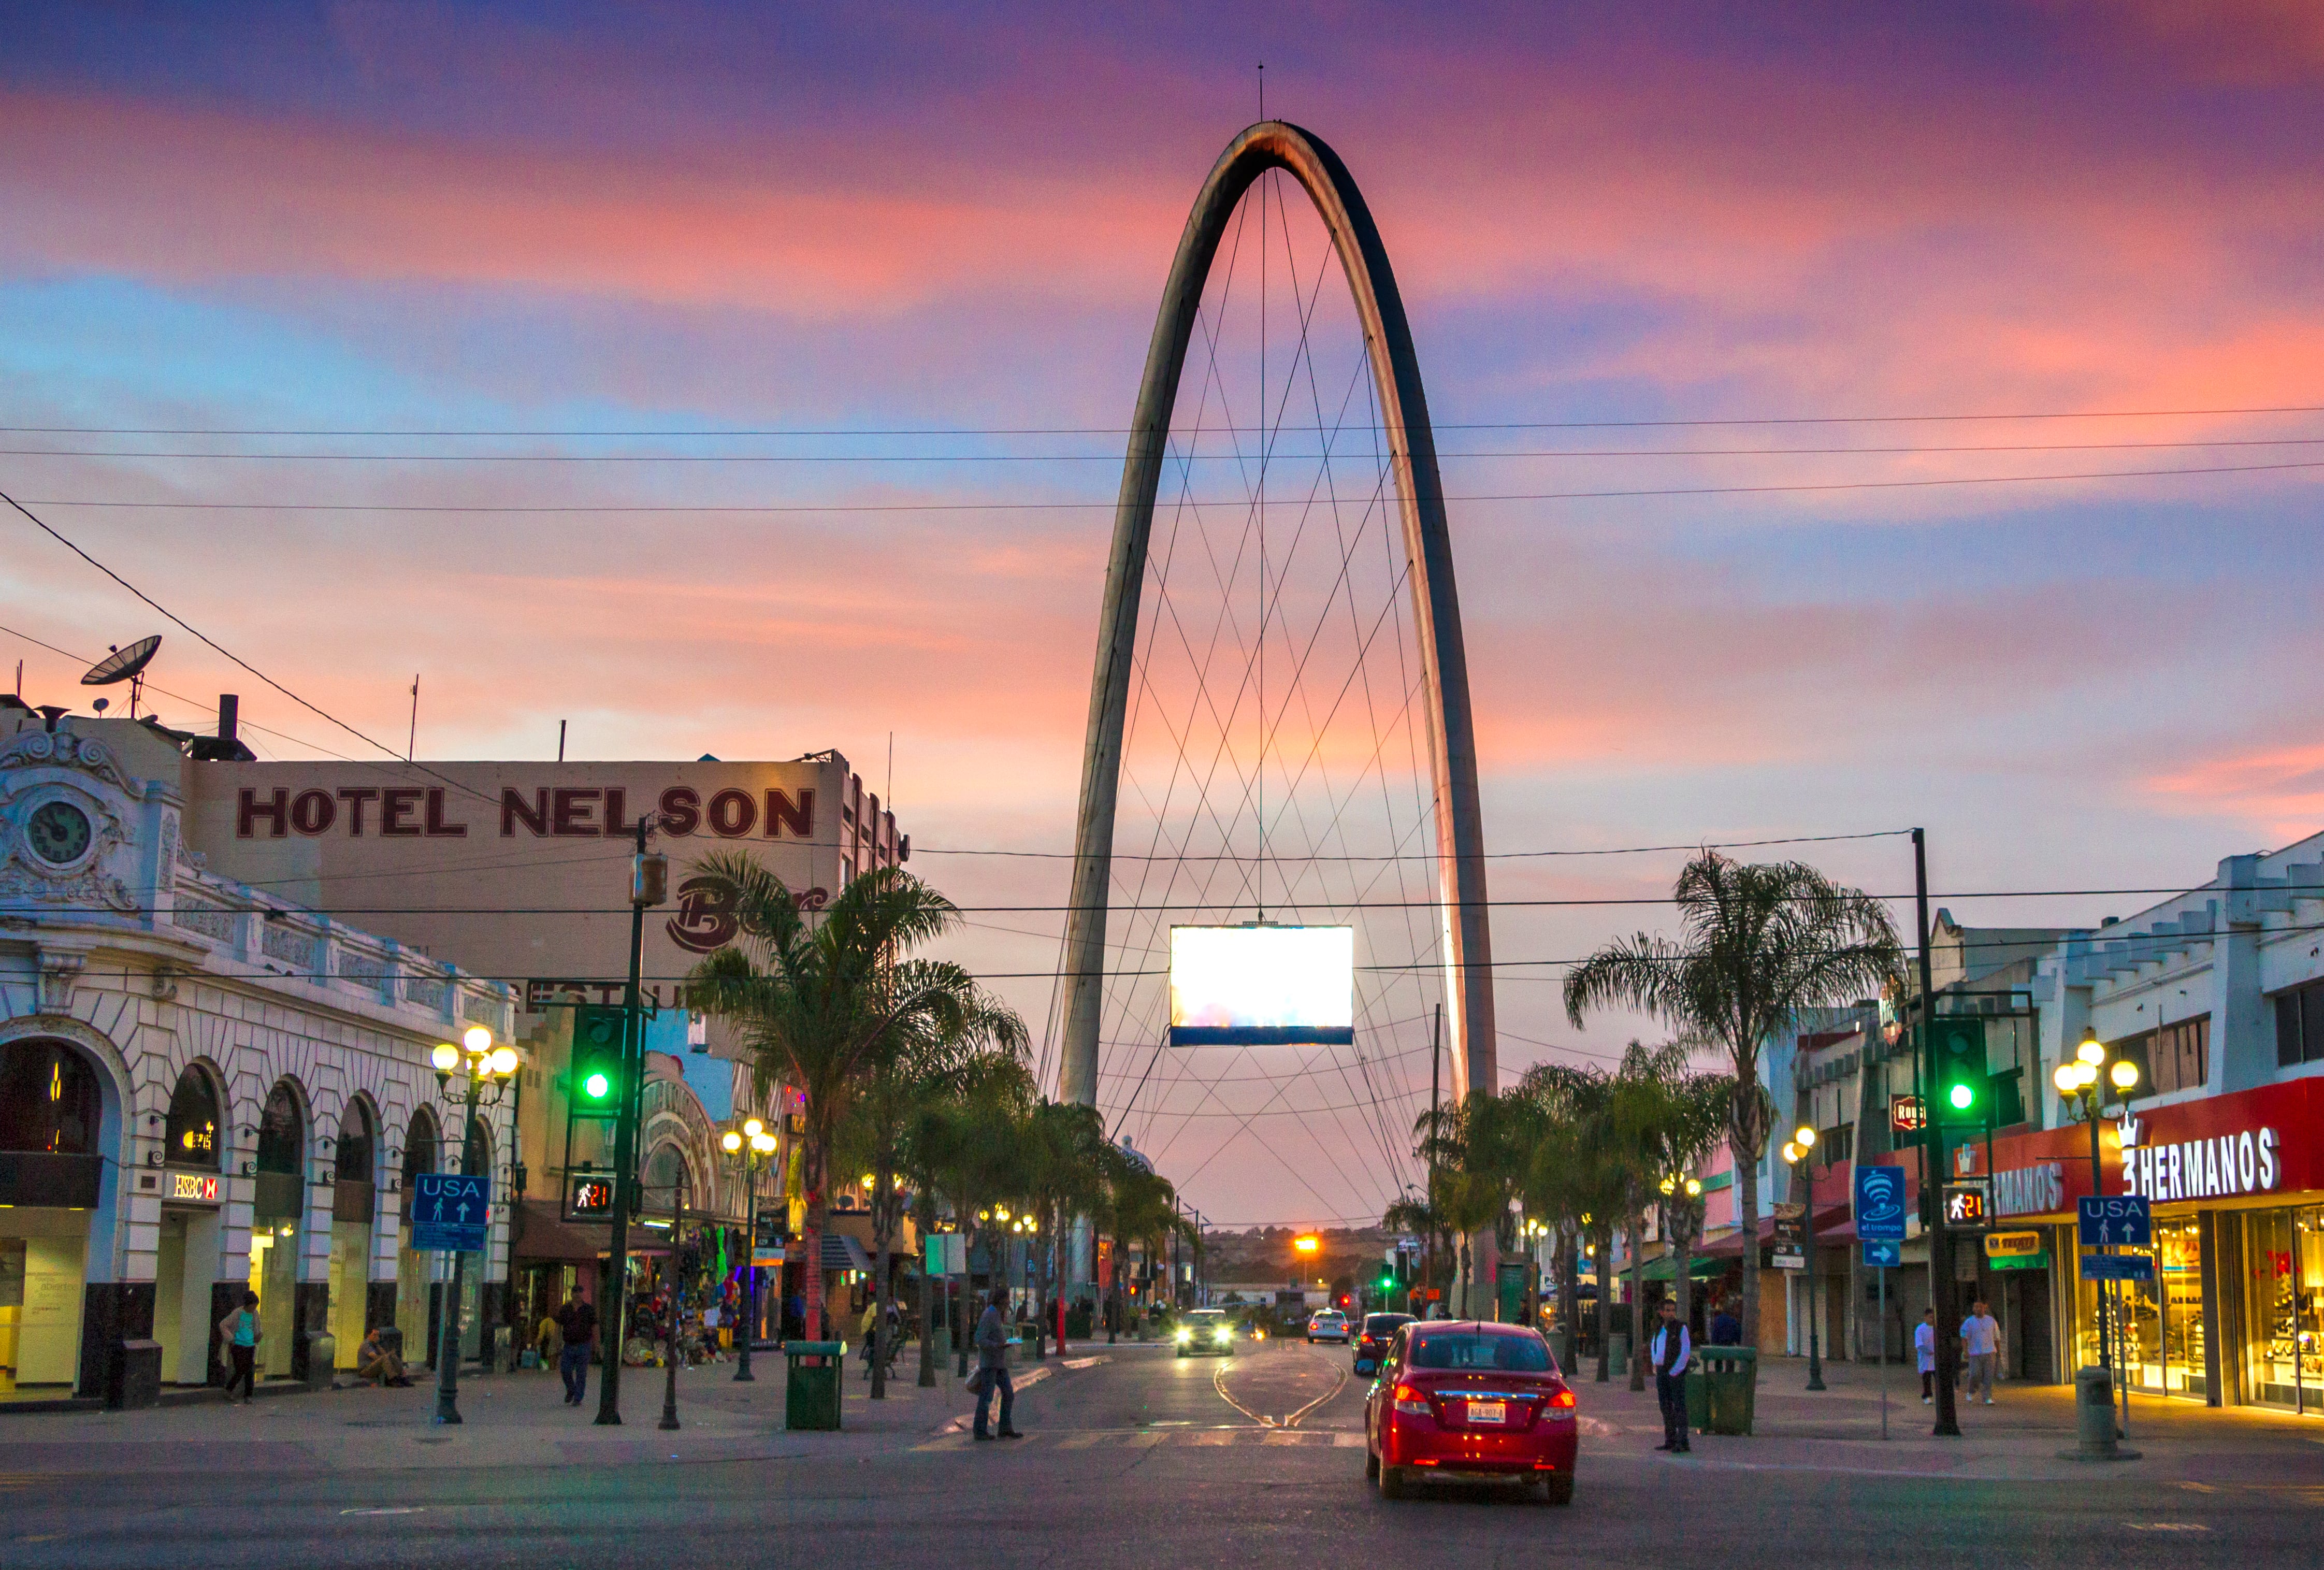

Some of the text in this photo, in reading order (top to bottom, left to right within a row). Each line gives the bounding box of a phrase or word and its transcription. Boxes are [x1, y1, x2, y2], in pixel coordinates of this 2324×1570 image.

[237, 786, 815, 838] HOTEL NELSON
[2140, 1127, 2274, 1201] HERMANOS
[174, 1174, 204, 1199] HSBC
[424, 1179, 480, 1198] USA
[590, 1185, 607, 1207] 21
[1965, 1194, 1981, 1217] 21
[2087, 1201, 2143, 1217] USA
